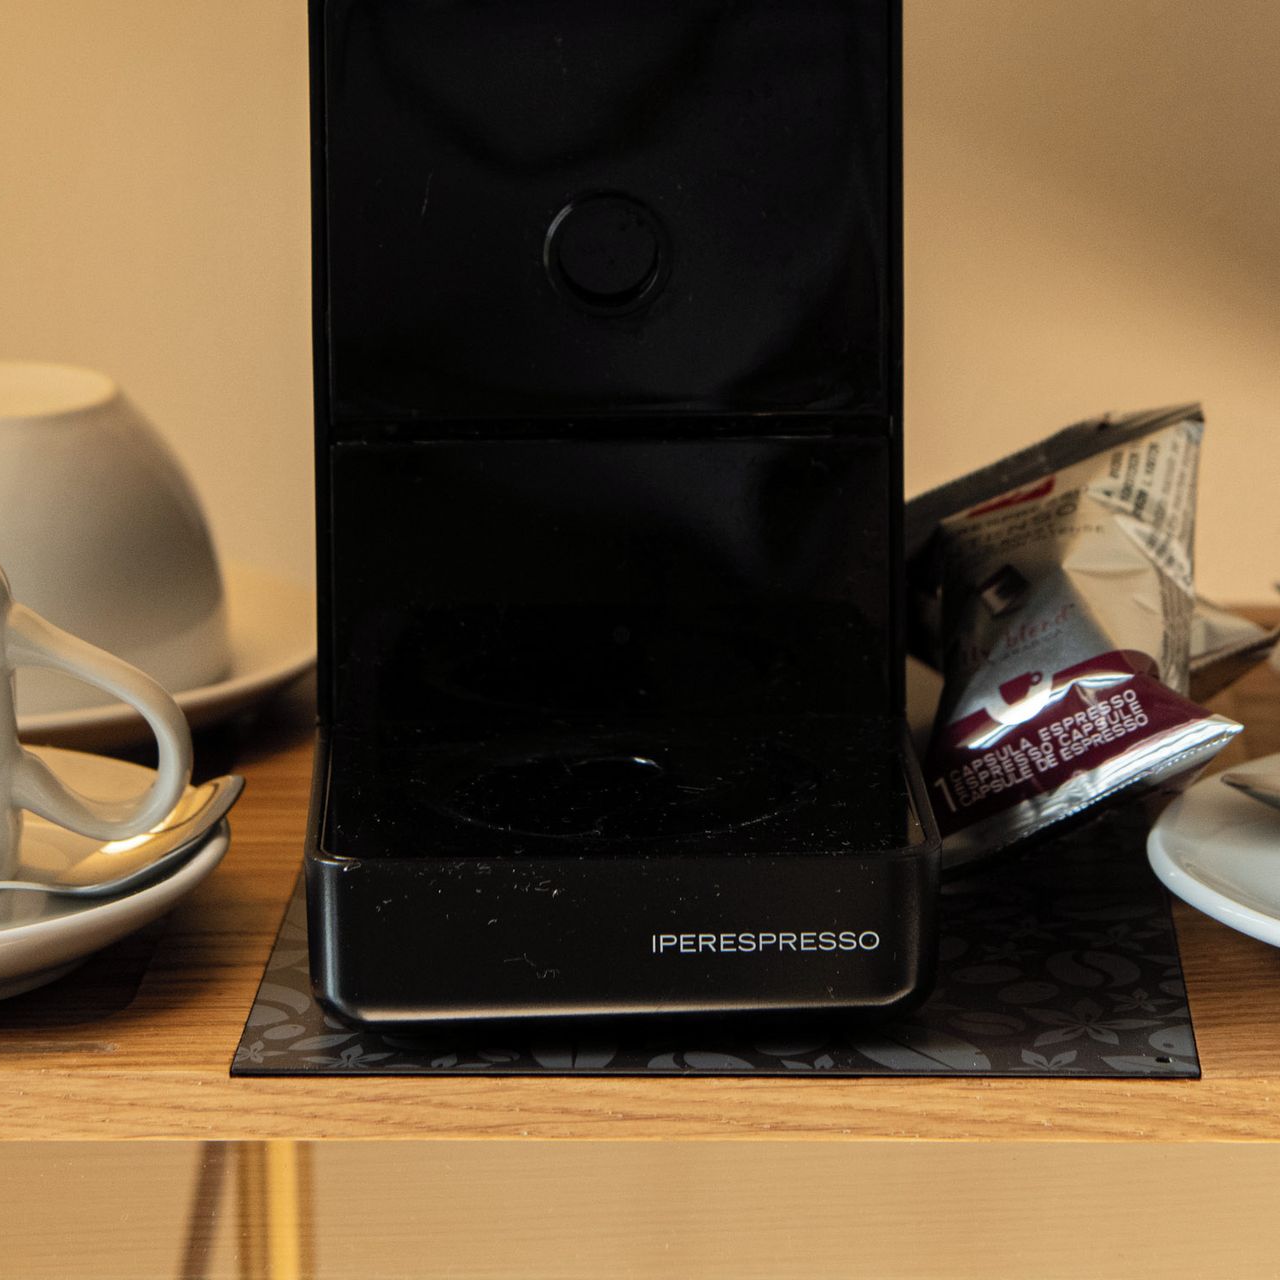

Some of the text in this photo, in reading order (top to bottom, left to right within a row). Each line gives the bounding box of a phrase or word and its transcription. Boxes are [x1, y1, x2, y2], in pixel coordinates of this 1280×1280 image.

[950, 688, 1137, 785] CAPSULA ESPRESSO
[954, 702, 1144, 797] ESPRESSO CAPSULE
[959, 713, 1149, 808] CAPSULE DE ESPRESSO
[934, 777, 957, 813] 1
[652, 930, 880, 953] IPERESPRESSO
